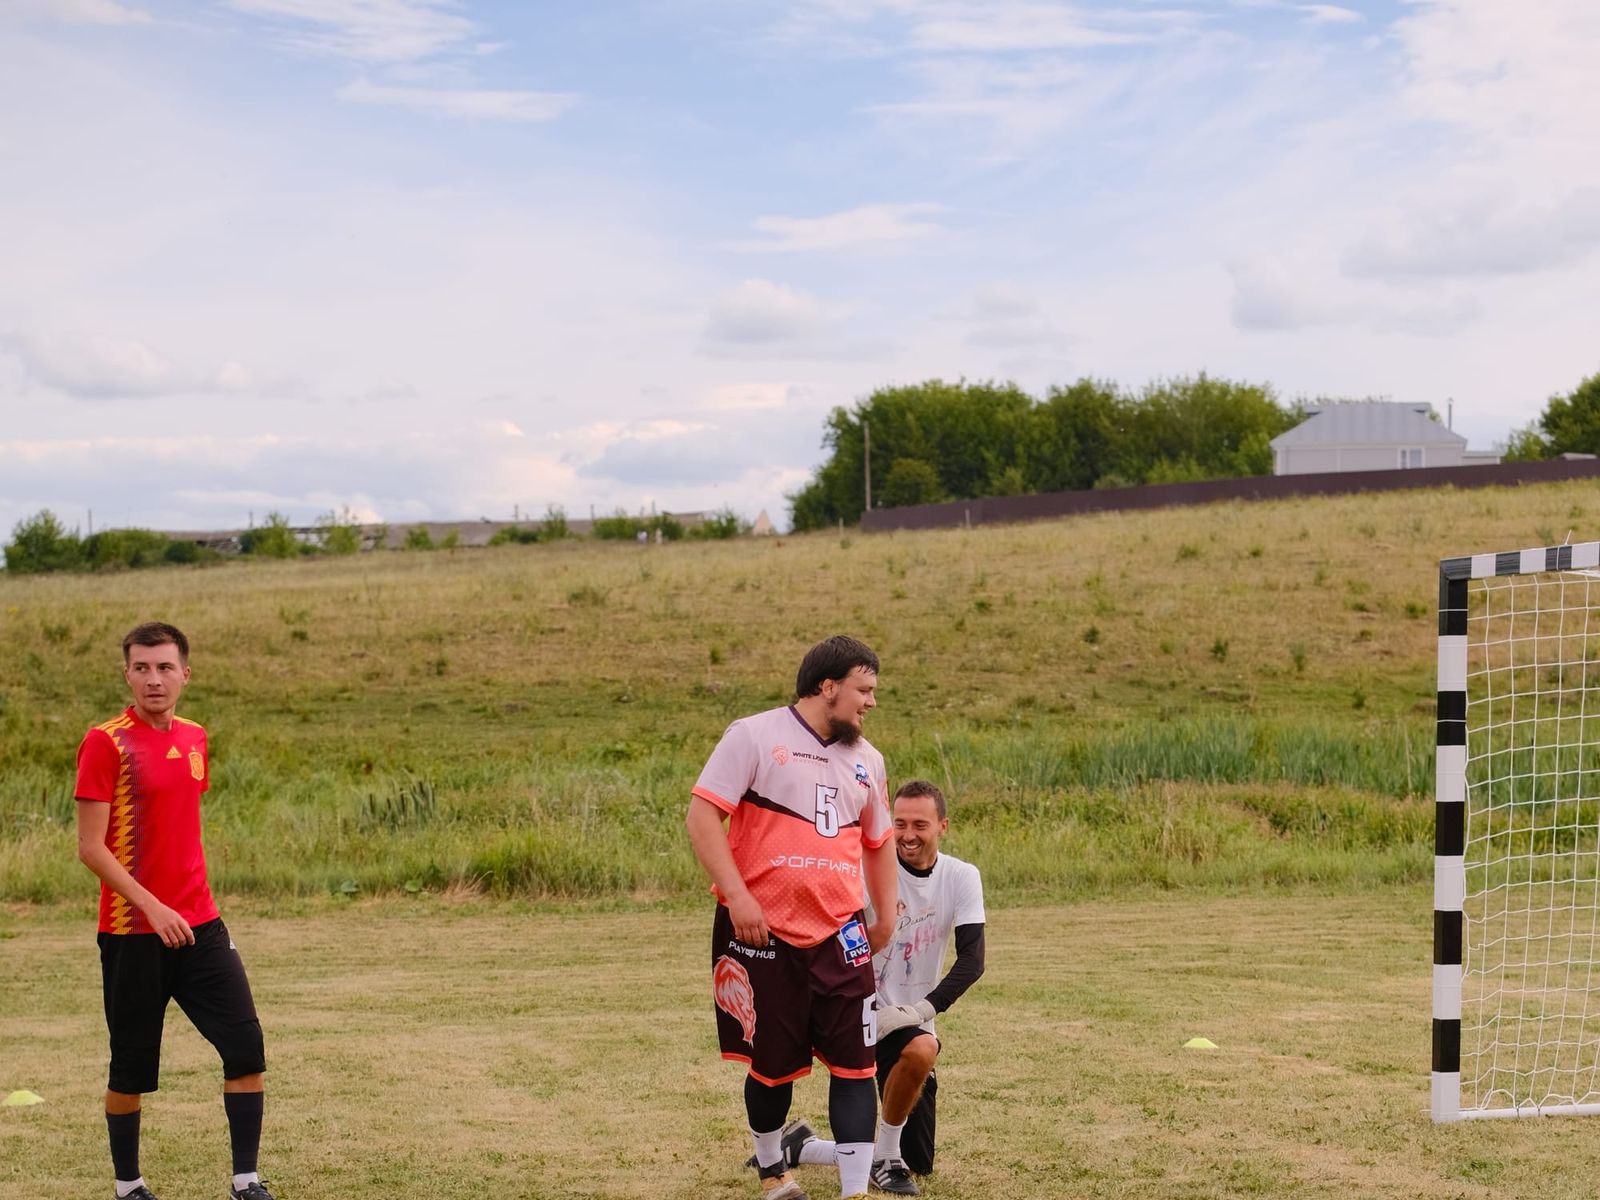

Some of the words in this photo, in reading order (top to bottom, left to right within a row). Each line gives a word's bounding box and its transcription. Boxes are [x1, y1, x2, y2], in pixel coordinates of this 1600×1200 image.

[815, 783, 839, 838] 5
[756, 950, 776, 959] HUB
[850, 944, 869, 958] RWC
[862, 993, 877, 1047] 5
